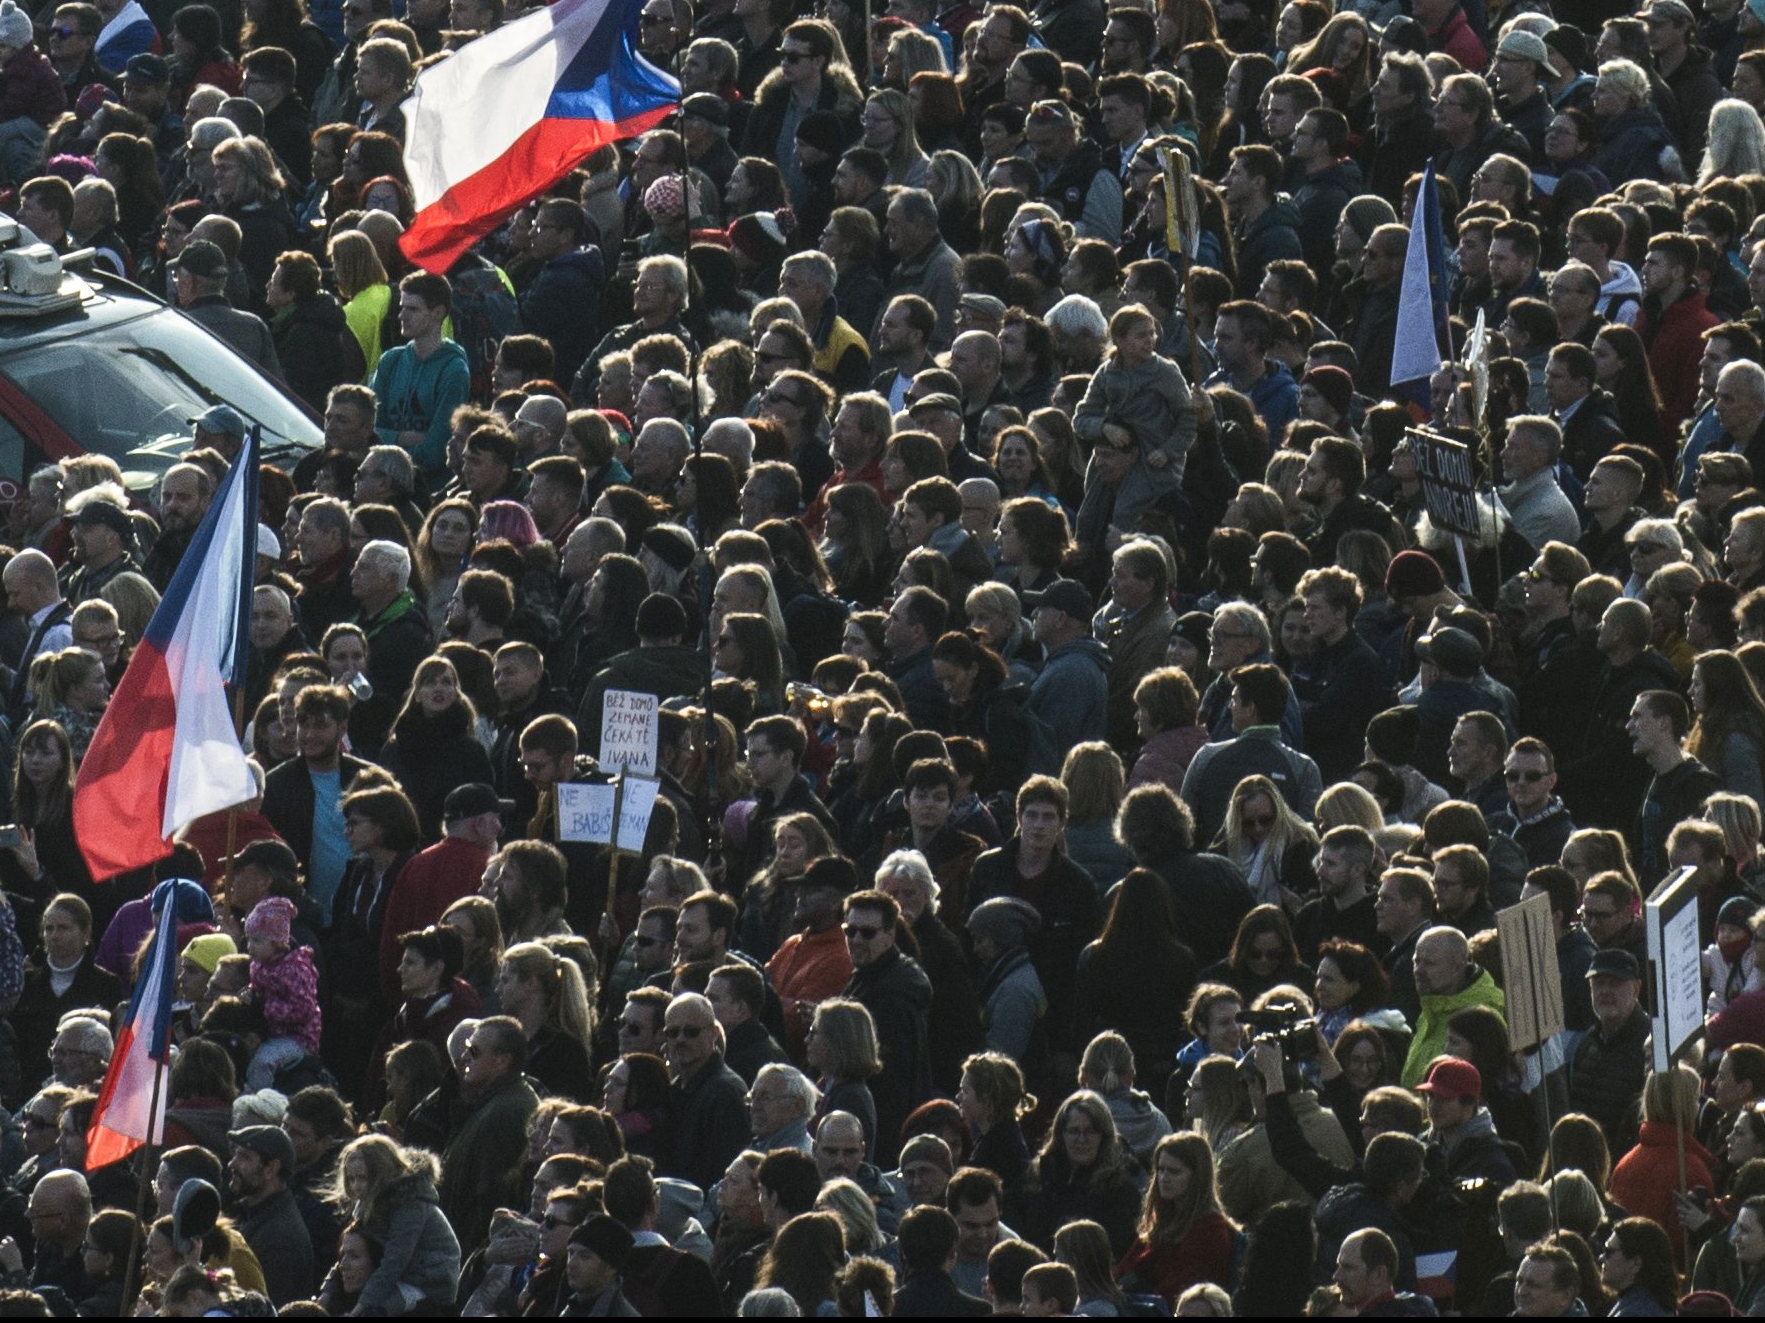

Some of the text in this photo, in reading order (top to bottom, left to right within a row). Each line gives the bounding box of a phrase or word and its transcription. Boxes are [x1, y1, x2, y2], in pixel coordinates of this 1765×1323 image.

[609, 712, 652, 726] ZEMANE
[607, 750, 649, 767] IVANA
[560, 789, 579, 807] NE
